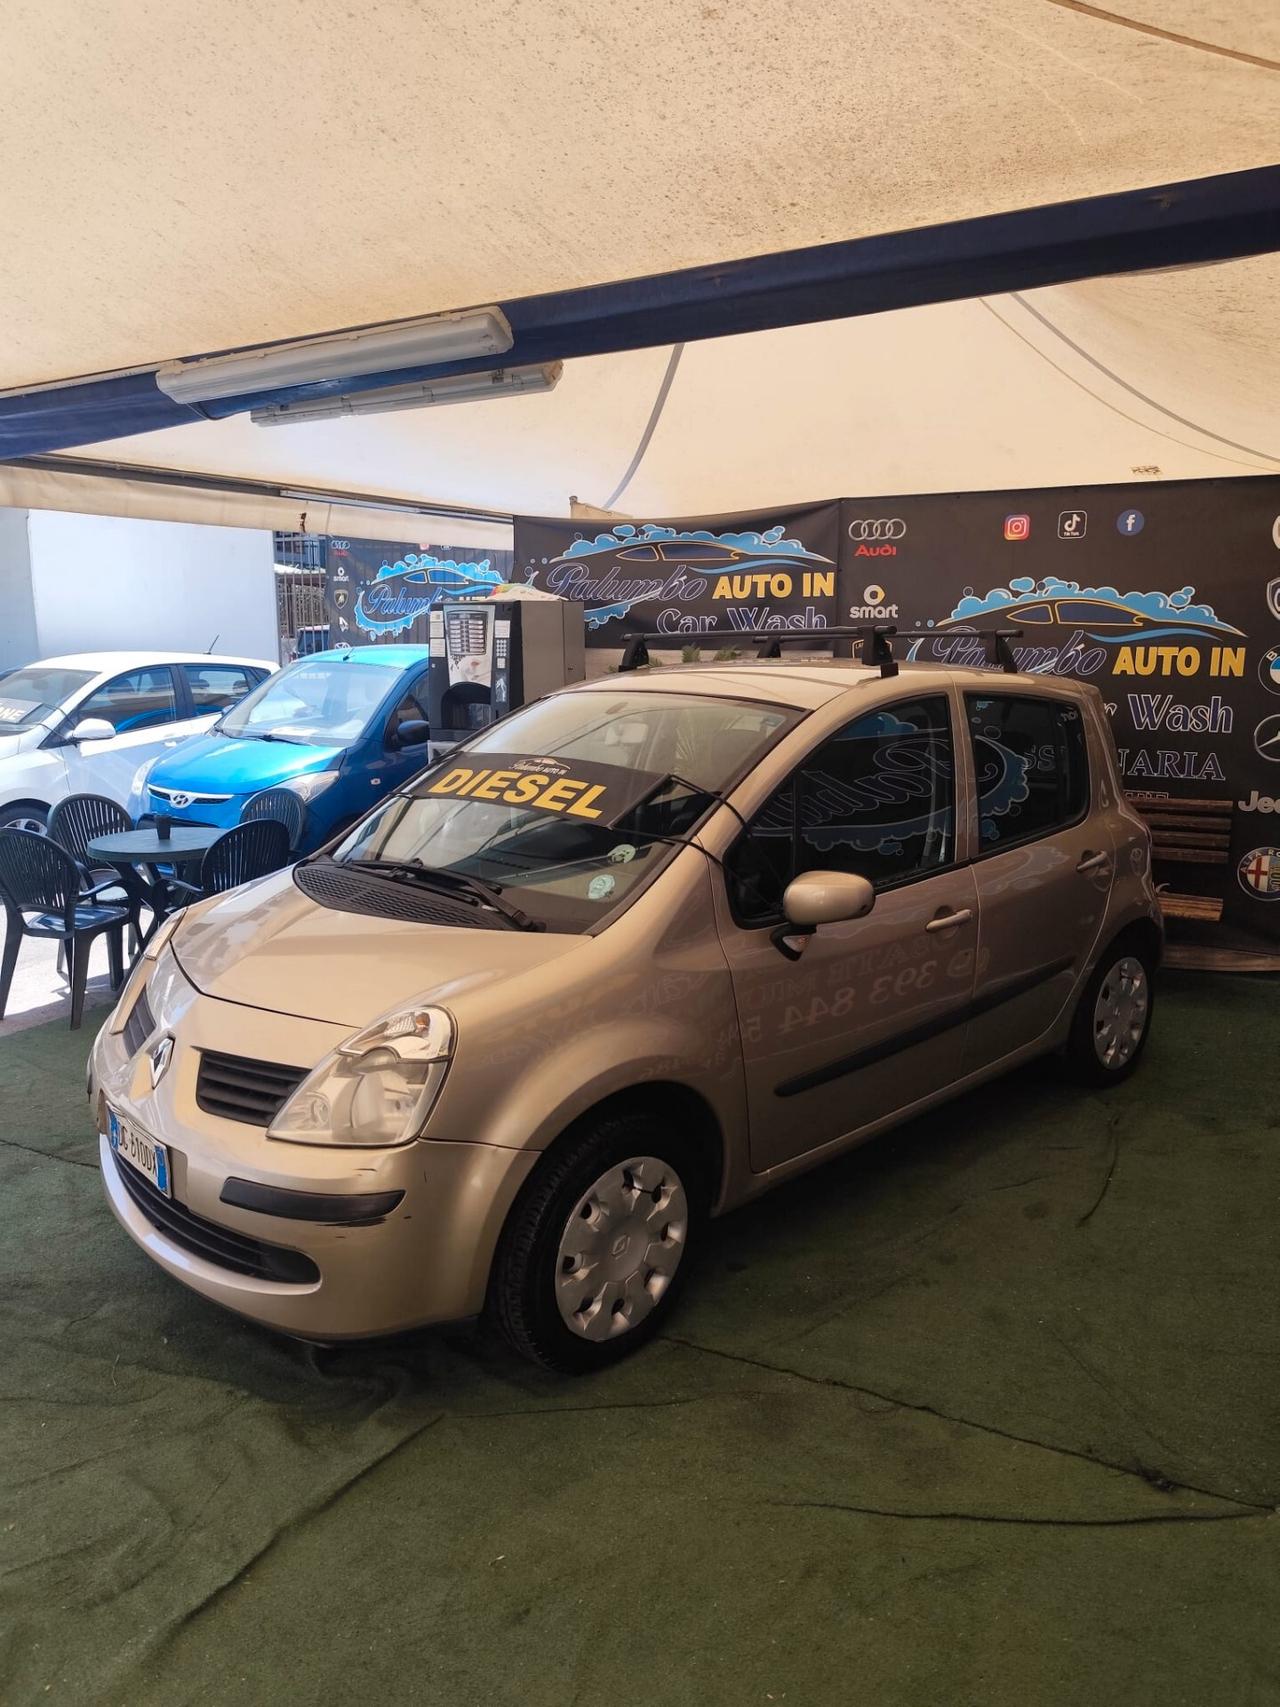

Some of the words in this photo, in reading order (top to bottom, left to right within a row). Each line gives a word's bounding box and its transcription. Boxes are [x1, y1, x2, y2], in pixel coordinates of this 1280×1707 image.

[854, 544, 897, 556] Audi
[546, 562, 708, 601] Palumbo
[712, 574, 793, 599] AUTO
[802, 572, 835, 598] IN
[656, 608, 718, 634] Car
[727, 606, 828, 632] Wash
[849, 604, 899, 619] smart
[932, 626, 1108, 676] Paumbo
[1112, 646, 1200, 676] AUTO
[1209, 647, 1246, 677] IN
[1127, 693, 1234, 734] Wash
[427, 768, 608, 819] DIESEL
